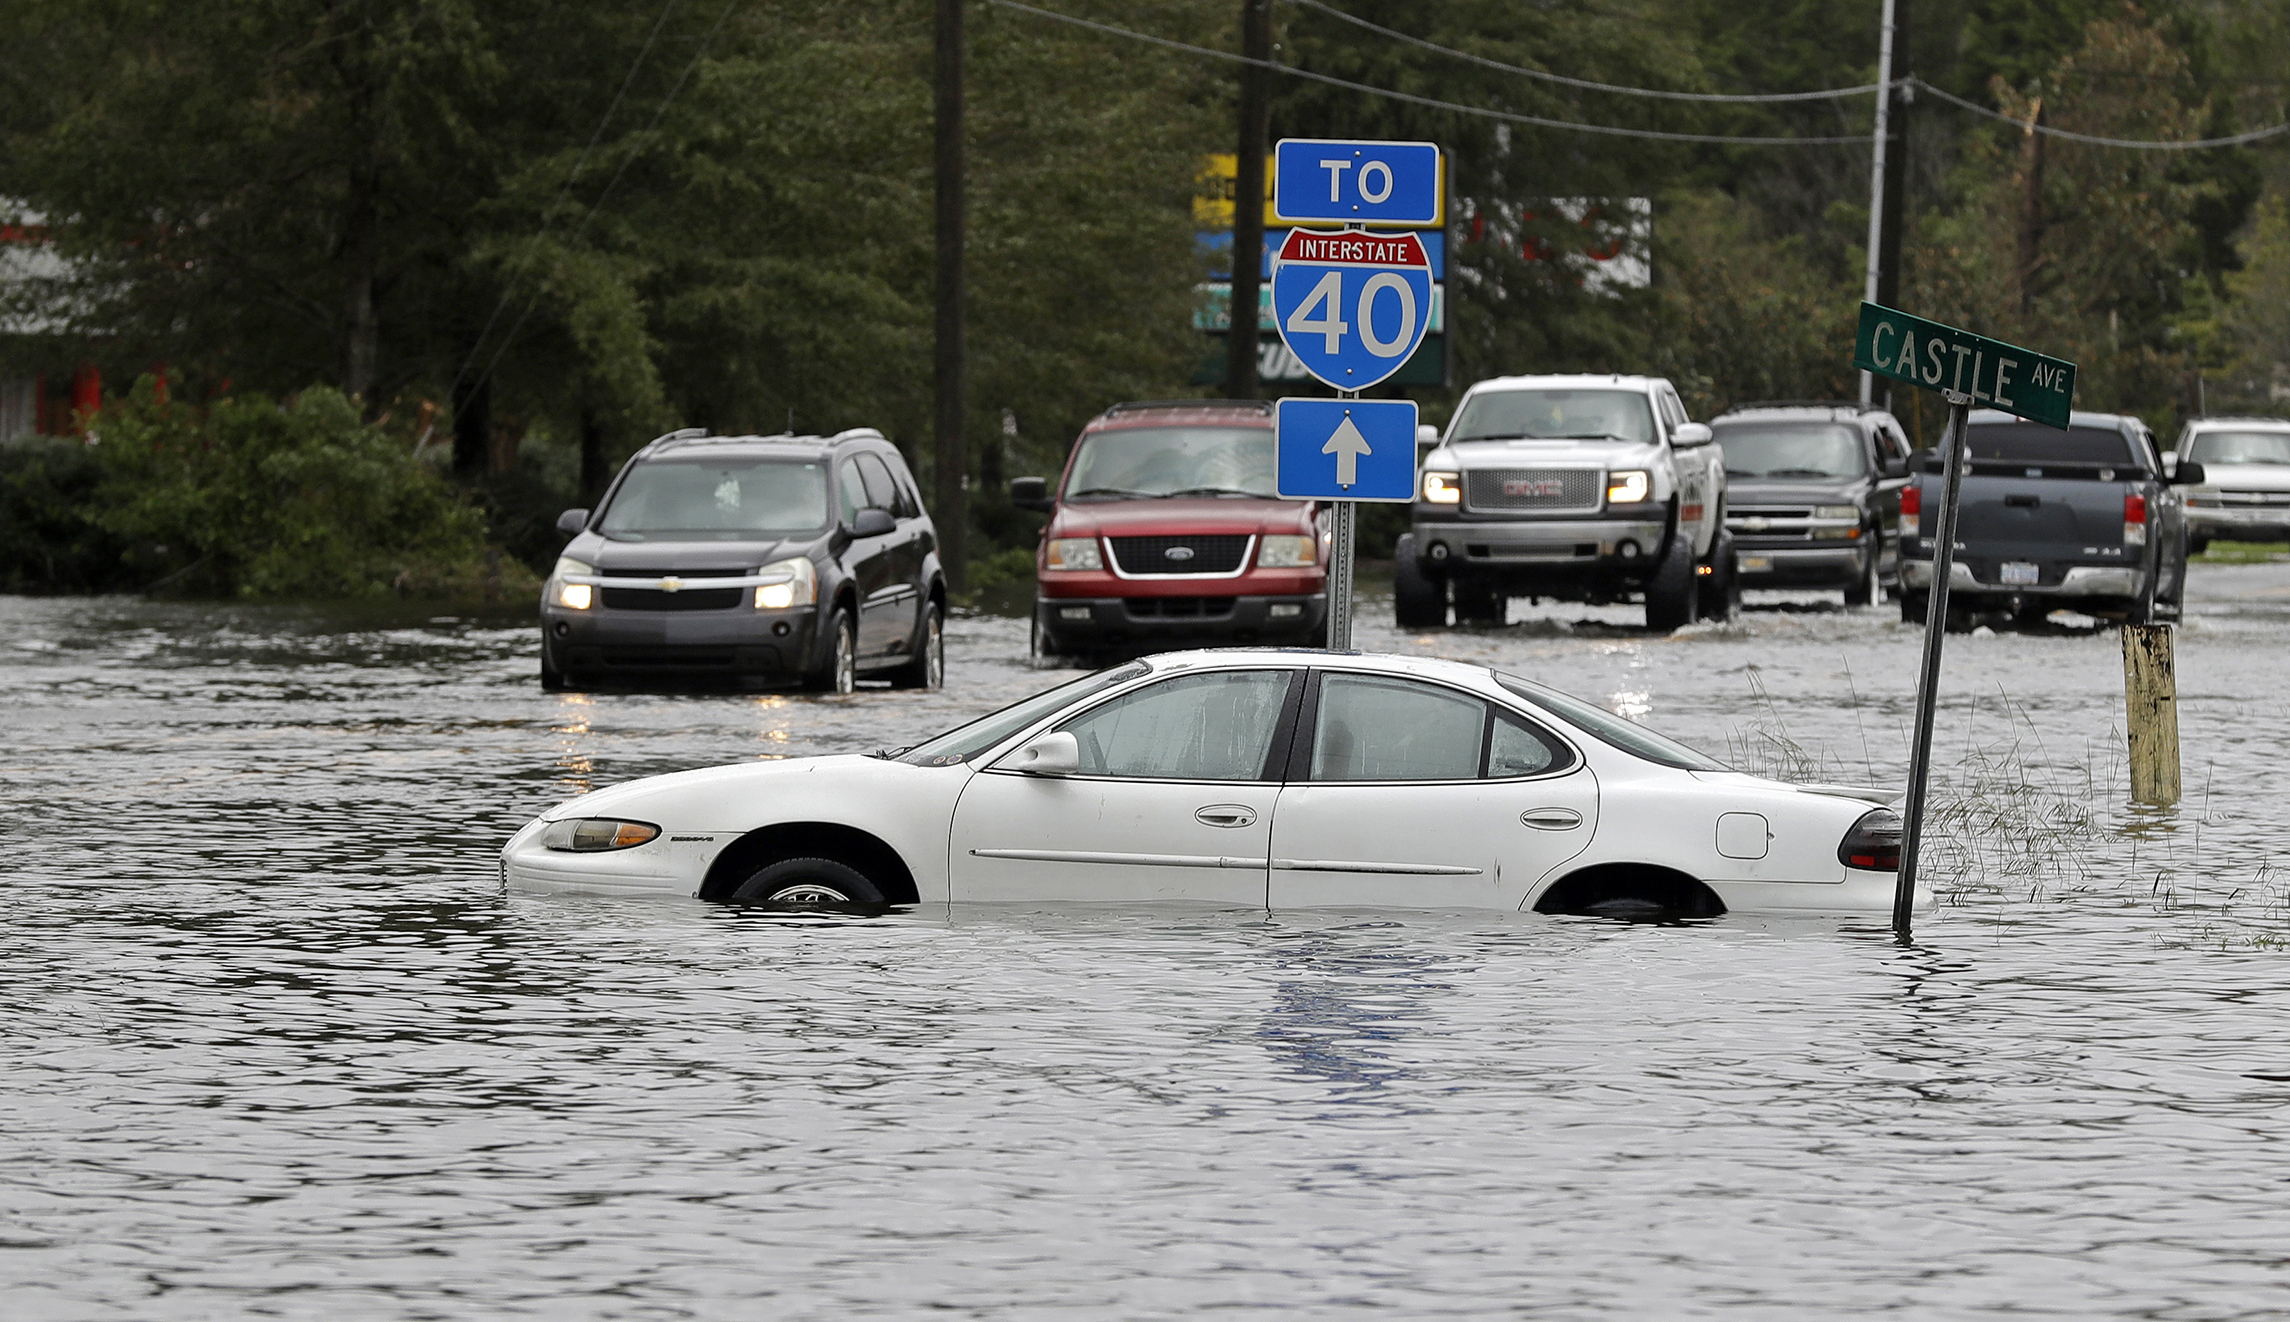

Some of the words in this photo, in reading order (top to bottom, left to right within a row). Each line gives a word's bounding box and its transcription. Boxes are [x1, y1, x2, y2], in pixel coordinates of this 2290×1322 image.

[1319, 159, 1394, 205] TO
[1299, 239, 1408, 263] INTERSTATE
[1286, 271, 1416, 358] 40
[1872, 321, 2018, 407] CASTLE
[2031, 362, 2067, 393] AVE
